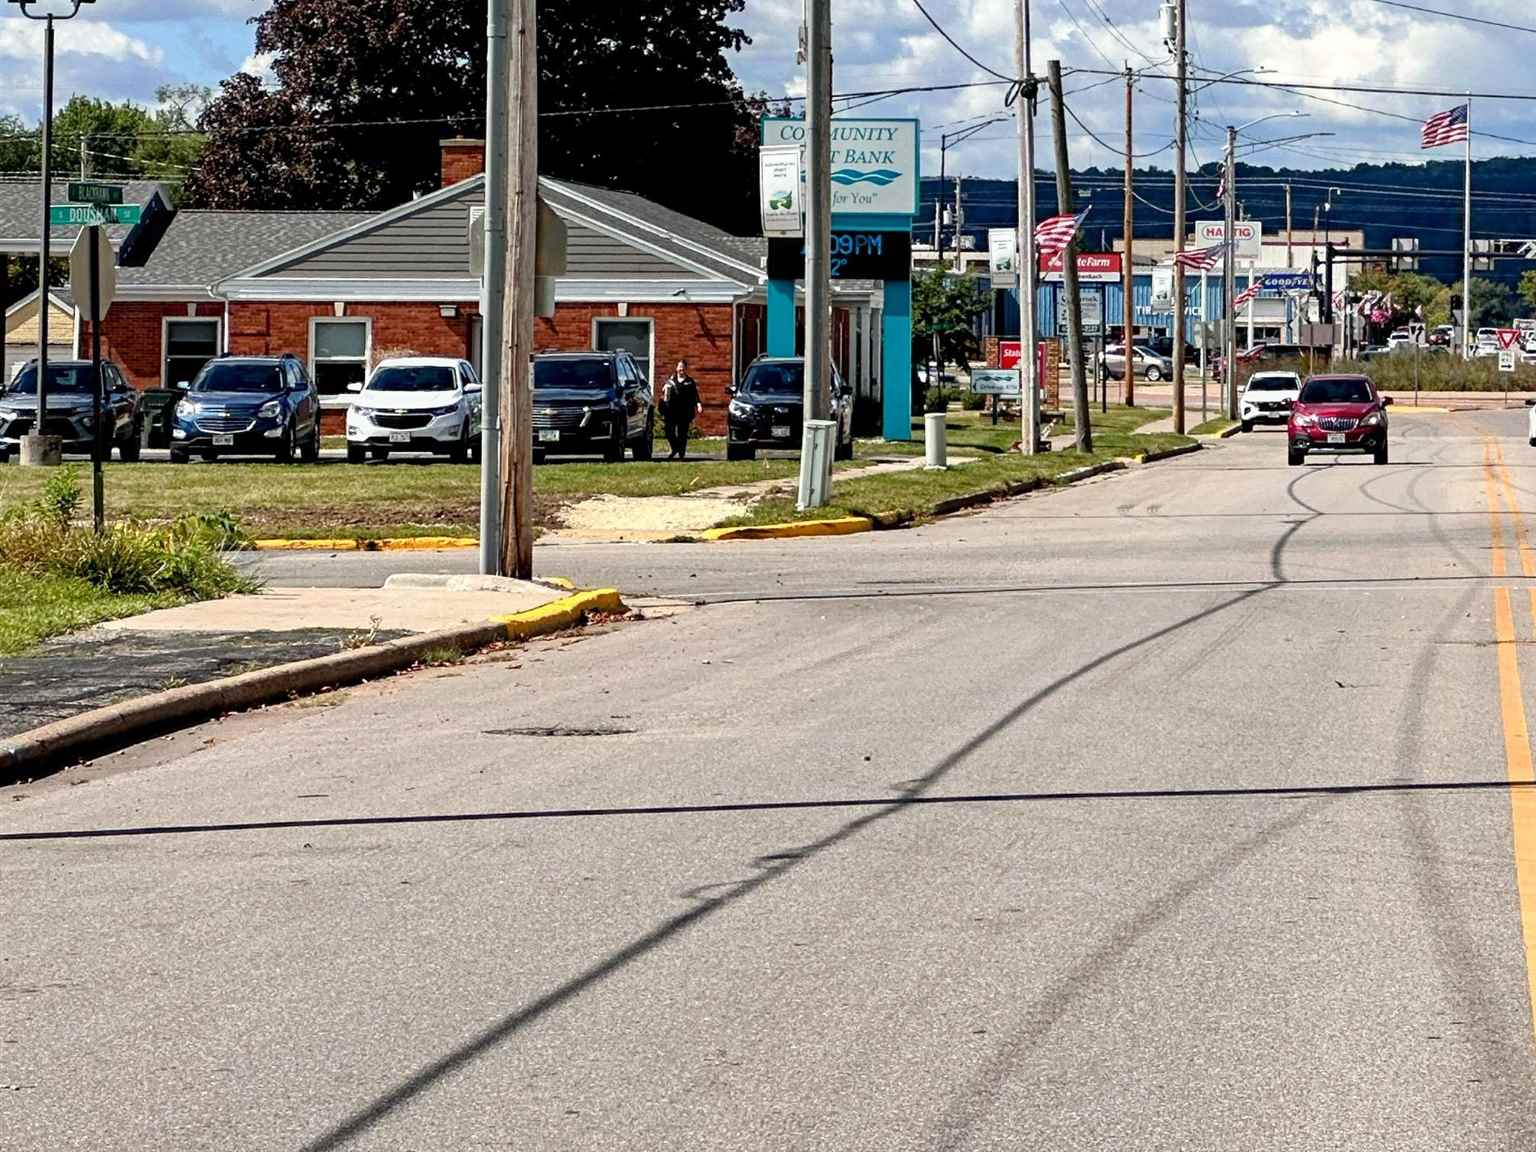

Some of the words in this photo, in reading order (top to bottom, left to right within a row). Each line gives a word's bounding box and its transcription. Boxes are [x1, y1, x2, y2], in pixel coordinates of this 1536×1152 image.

[843, 149, 896, 164] BANK
[1206, 228, 1251, 237] HATIG
[1264, 278, 1309, 287] GOODYE
